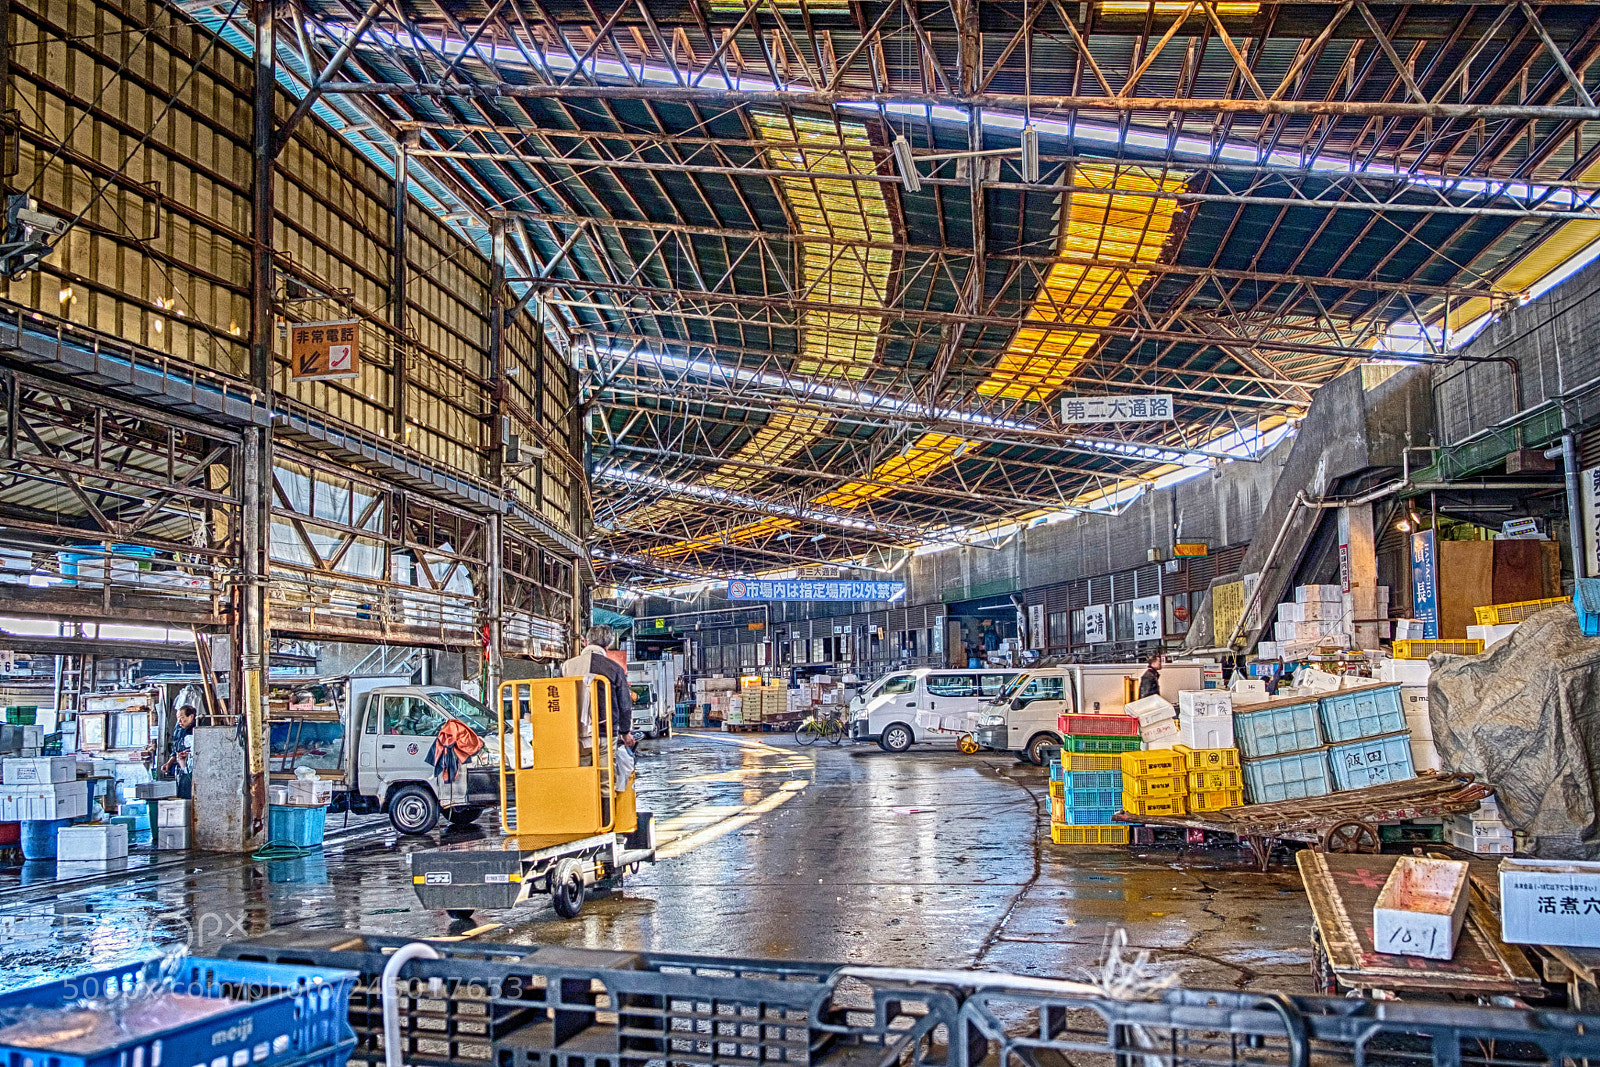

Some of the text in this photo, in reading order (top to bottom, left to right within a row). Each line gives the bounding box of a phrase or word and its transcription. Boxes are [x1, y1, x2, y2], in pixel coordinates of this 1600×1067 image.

[296, 327, 354, 344] 非常電話
[1066, 398, 1168, 420] 第二大通路
[547, 685, 560, 713] 亀福
[1345, 750, 1382, 769] 飯田
[1537, 896, 1600, 915] 活煮穴
[211, 1015, 253, 1045] meiji
